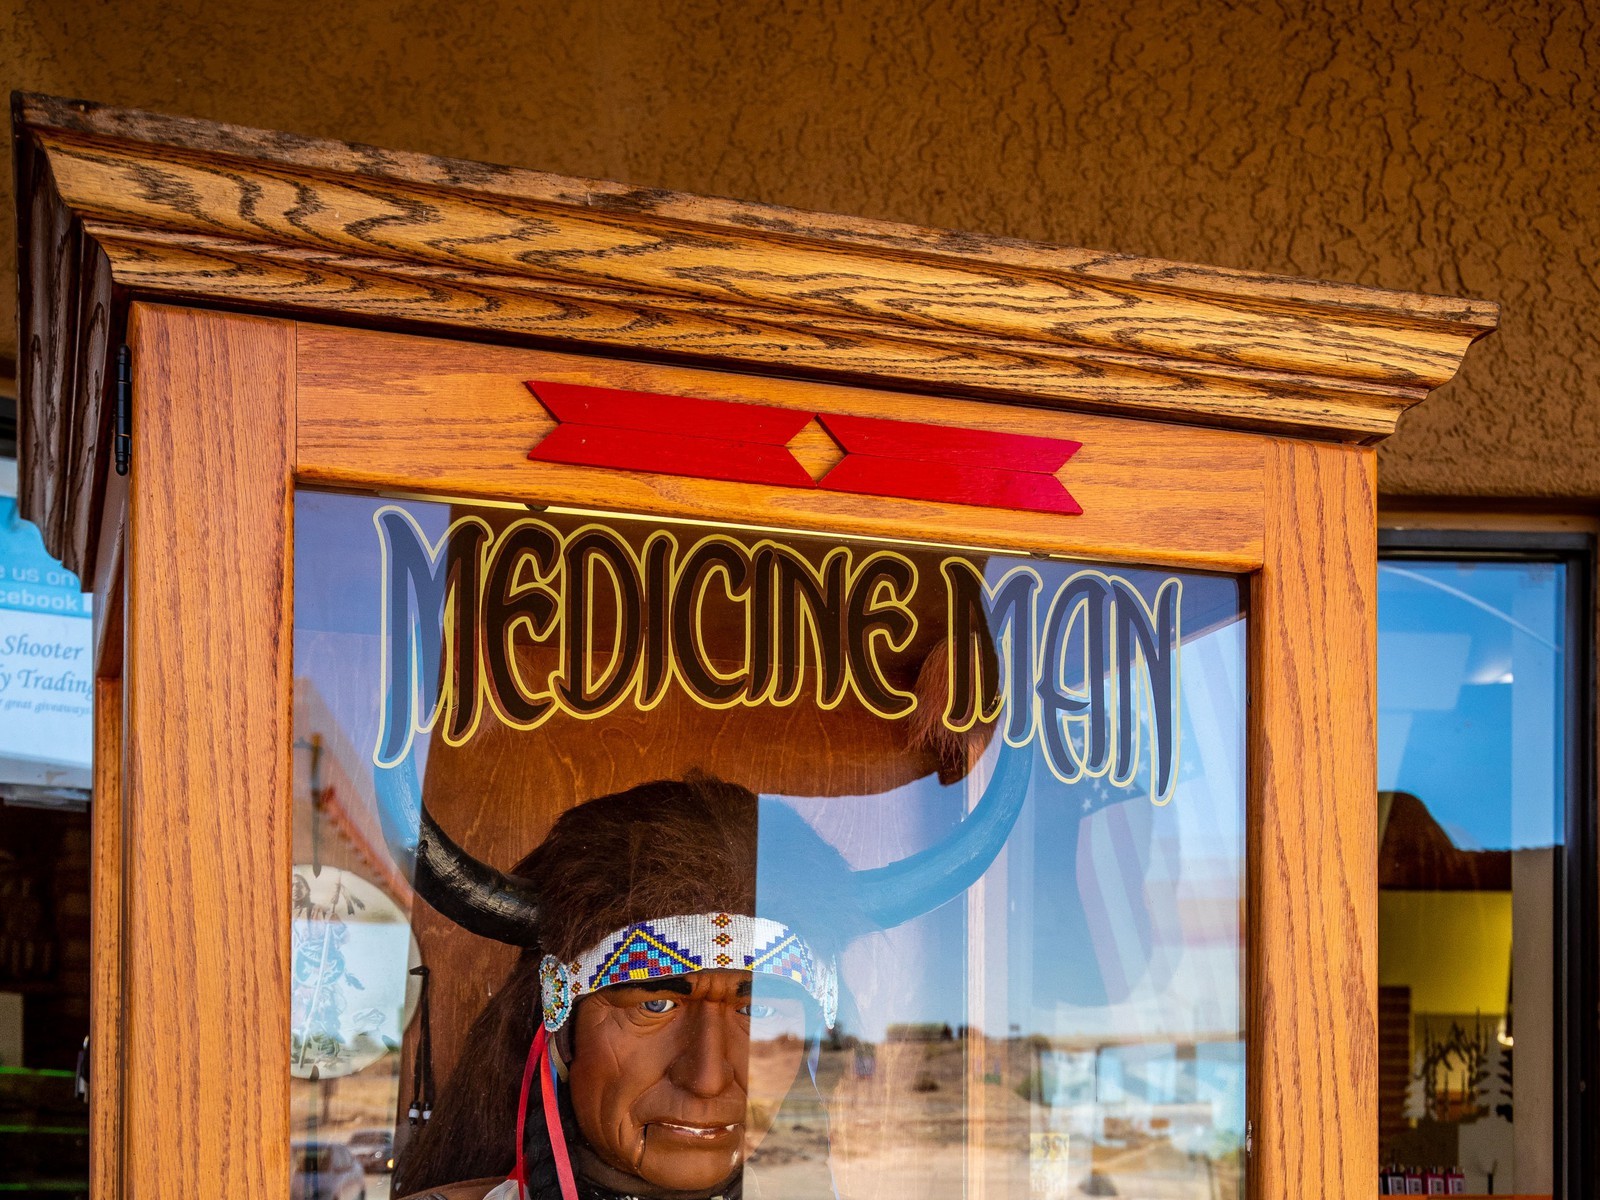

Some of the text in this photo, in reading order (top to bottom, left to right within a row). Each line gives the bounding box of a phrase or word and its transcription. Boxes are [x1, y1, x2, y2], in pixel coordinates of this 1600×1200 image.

[12, 566, 40, 583] us
[46, 570, 75, 586] on
[1, 633, 84, 661] Shooter
[373, 506, 1182, 806] MEDICINE MAN
